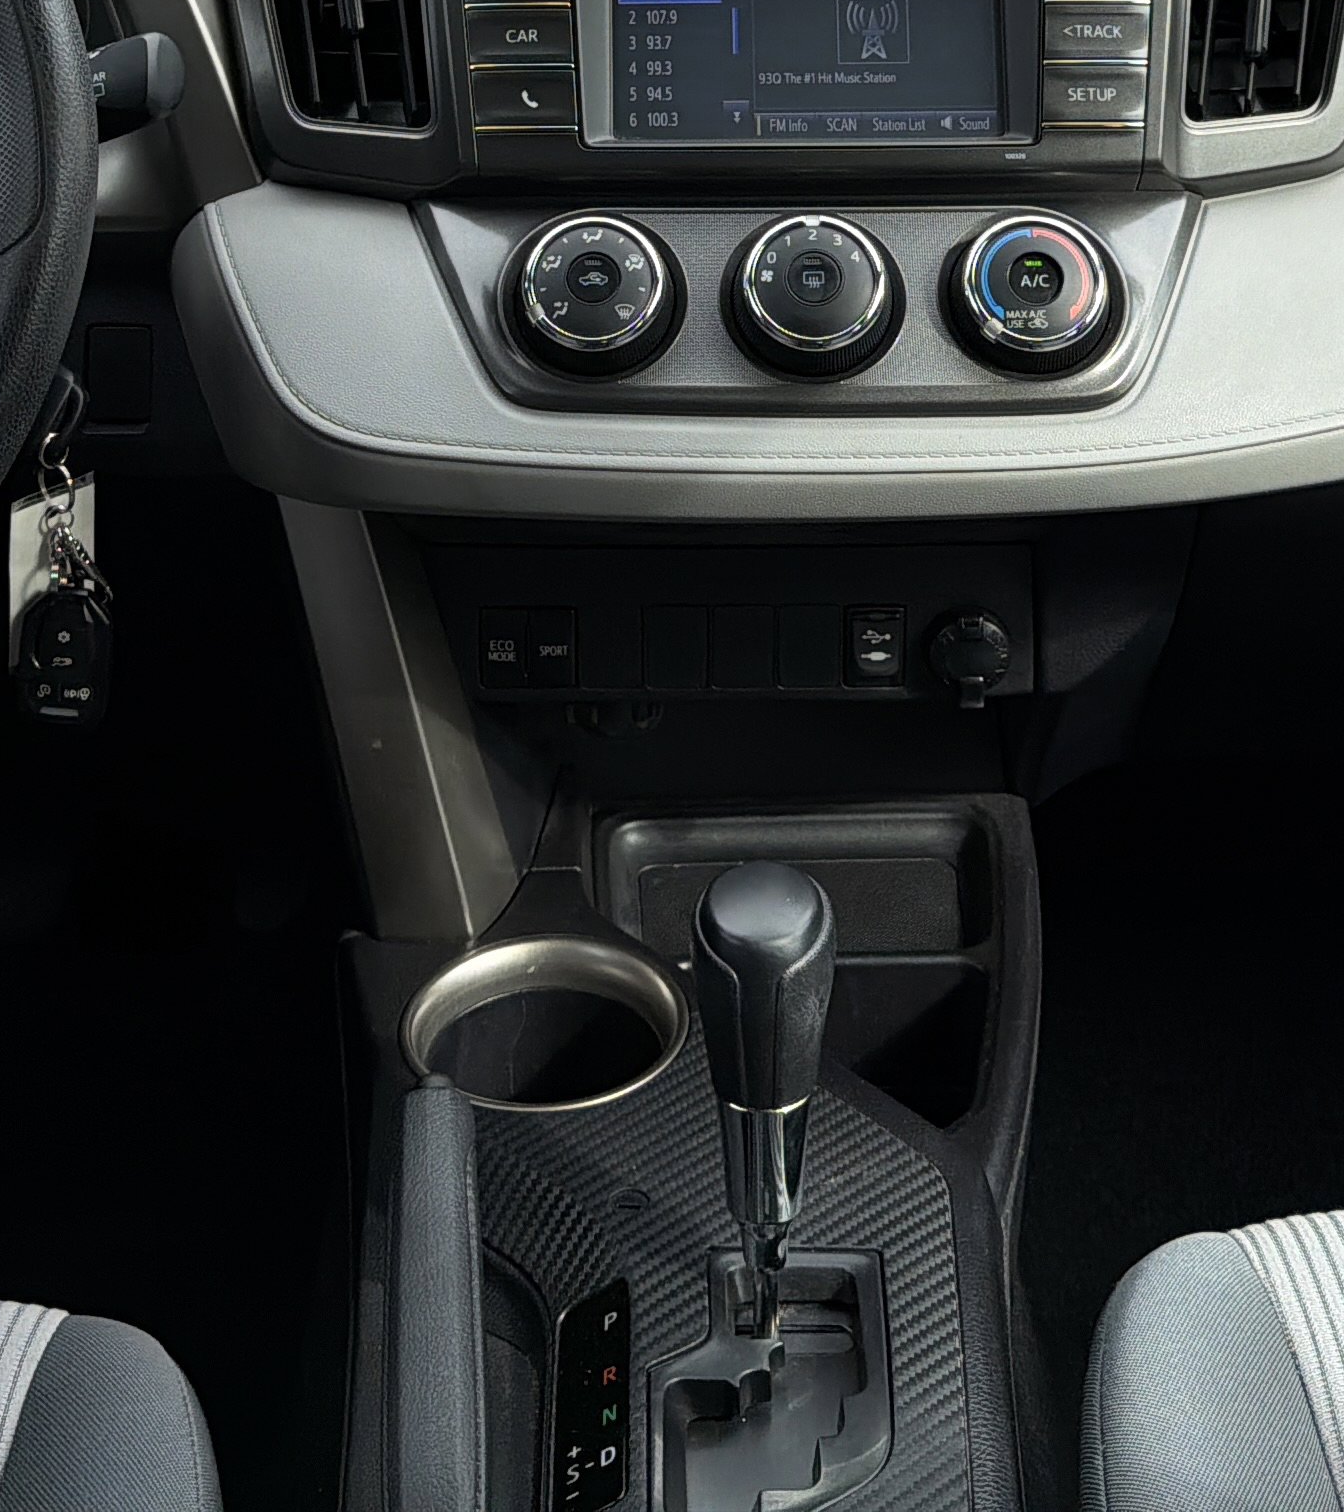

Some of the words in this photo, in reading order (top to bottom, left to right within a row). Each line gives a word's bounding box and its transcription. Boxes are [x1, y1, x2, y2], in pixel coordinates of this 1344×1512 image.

[628, 11, 637, 25] 2
[645, 10, 678, 25] 107.9
[505, 29, 539, 43] CAR
[629, 36, 637, 50] 3
[646, 35, 672, 50] 93.7
[628, 62, 637, 76] 4
[646, 61, 673, 76] 99.3
[784, 72, 802, 84] The
[804, 72, 816, 84] #1
[818, 71, 833, 84] Hit
[834, 72, 862, 84] Music
[863, 71, 897, 84] Station
[629, 87, 637, 101] 5
[646, 86, 673, 101] 94.5
[1067, 87, 1117, 102] SETUP
[629, 113, 638, 127] 6
[647, 112, 679, 127] 100.3
[769, 119, 787, 132] FM
[788, 119, 808, 133] Info
[826, 119, 857, 132] SCAN
[872, 119, 906, 132] Station
[908, 118, 926, 131] List
[959, 117, 990, 131] Sound
[784, 234, 791, 247] 1
[808, 229, 817, 241] 2
[832, 233, 843, 247] 3
[850, 250, 861, 263] 4
[1020, 273, 1051, 288] A/C
[1006, 309, 1028, 319] MAX
[1029, 309, 1047, 319] A/C
[1006, 319, 1025, 329] USE
[489, 640, 514, 651] ECO
[538, 644, 569, 657] SPORT
[487, 650, 517, 663] MODE
[603, 1311, 618, 1331] P
[602, 1365, 618, 1385] R
[601, 1403, 617, 1427] N
[600, 1445, 617, 1467] D
[566, 1463, 580, 1486] S
